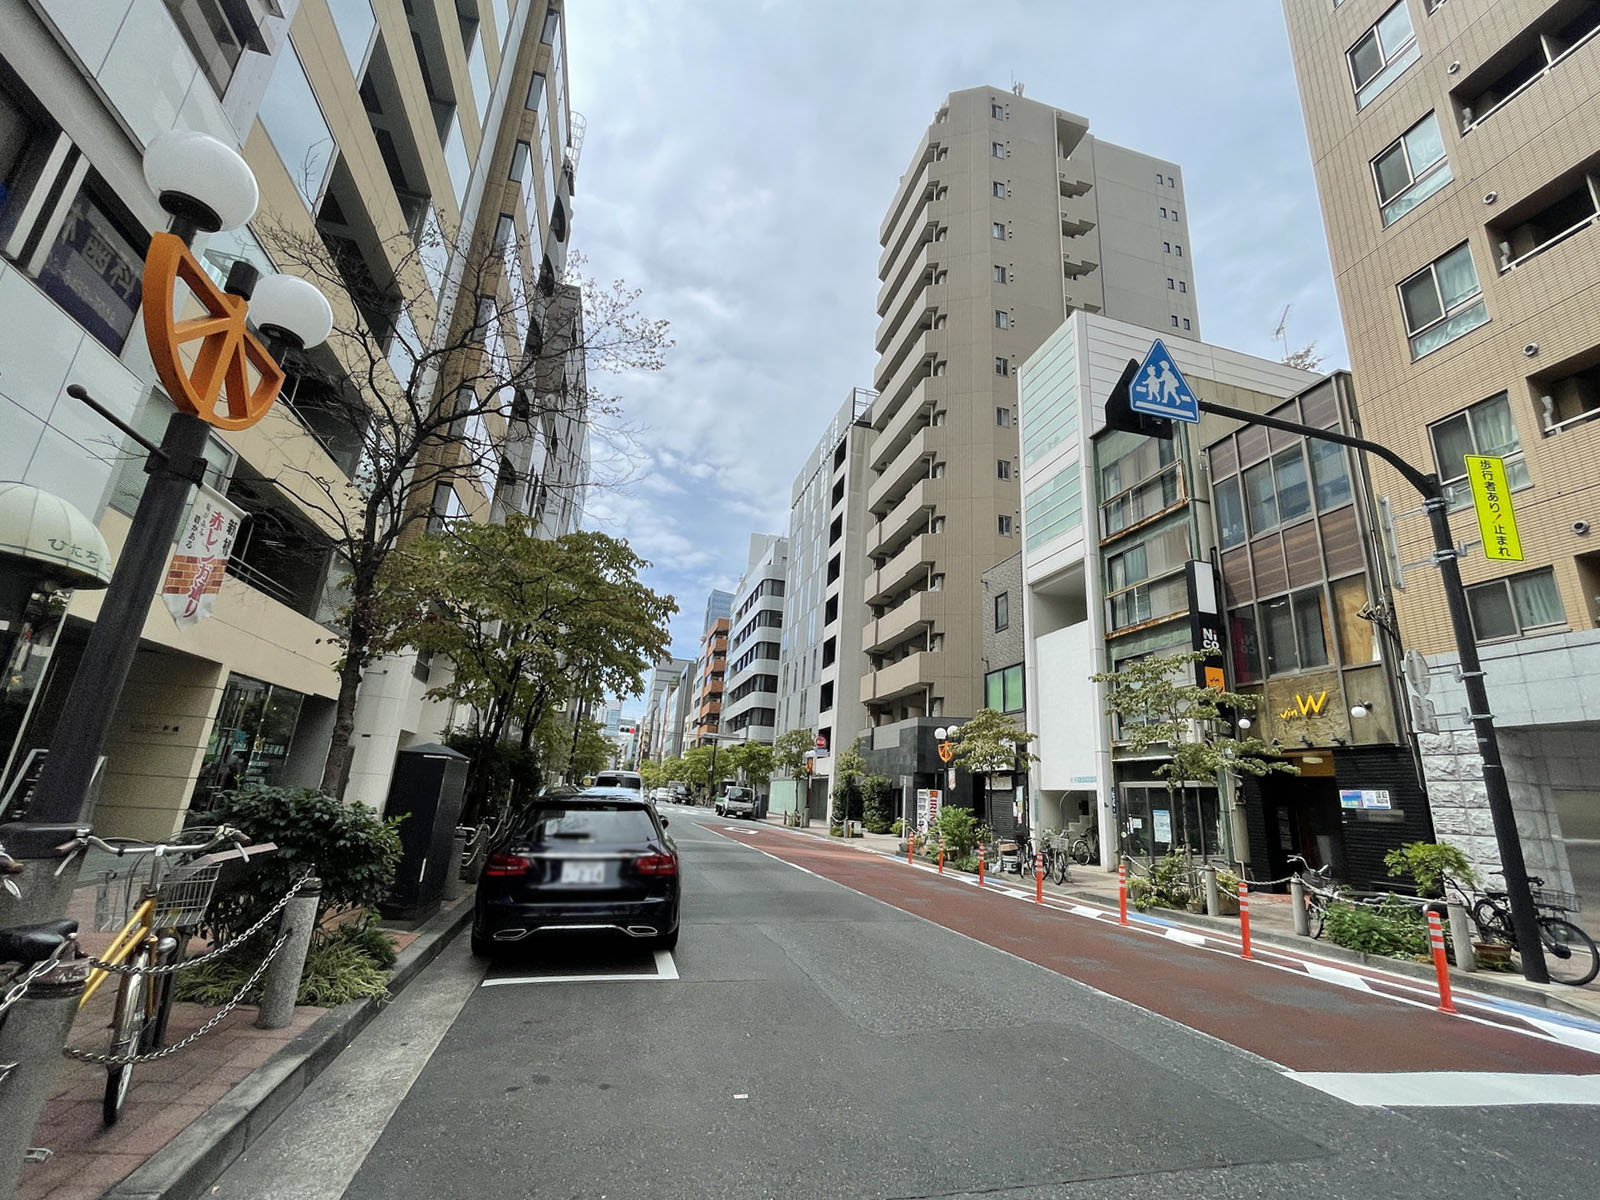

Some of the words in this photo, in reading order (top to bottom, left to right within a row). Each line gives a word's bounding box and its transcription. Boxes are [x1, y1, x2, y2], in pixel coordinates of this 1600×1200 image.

[183, 511, 224, 618] 赤レンガ通り
